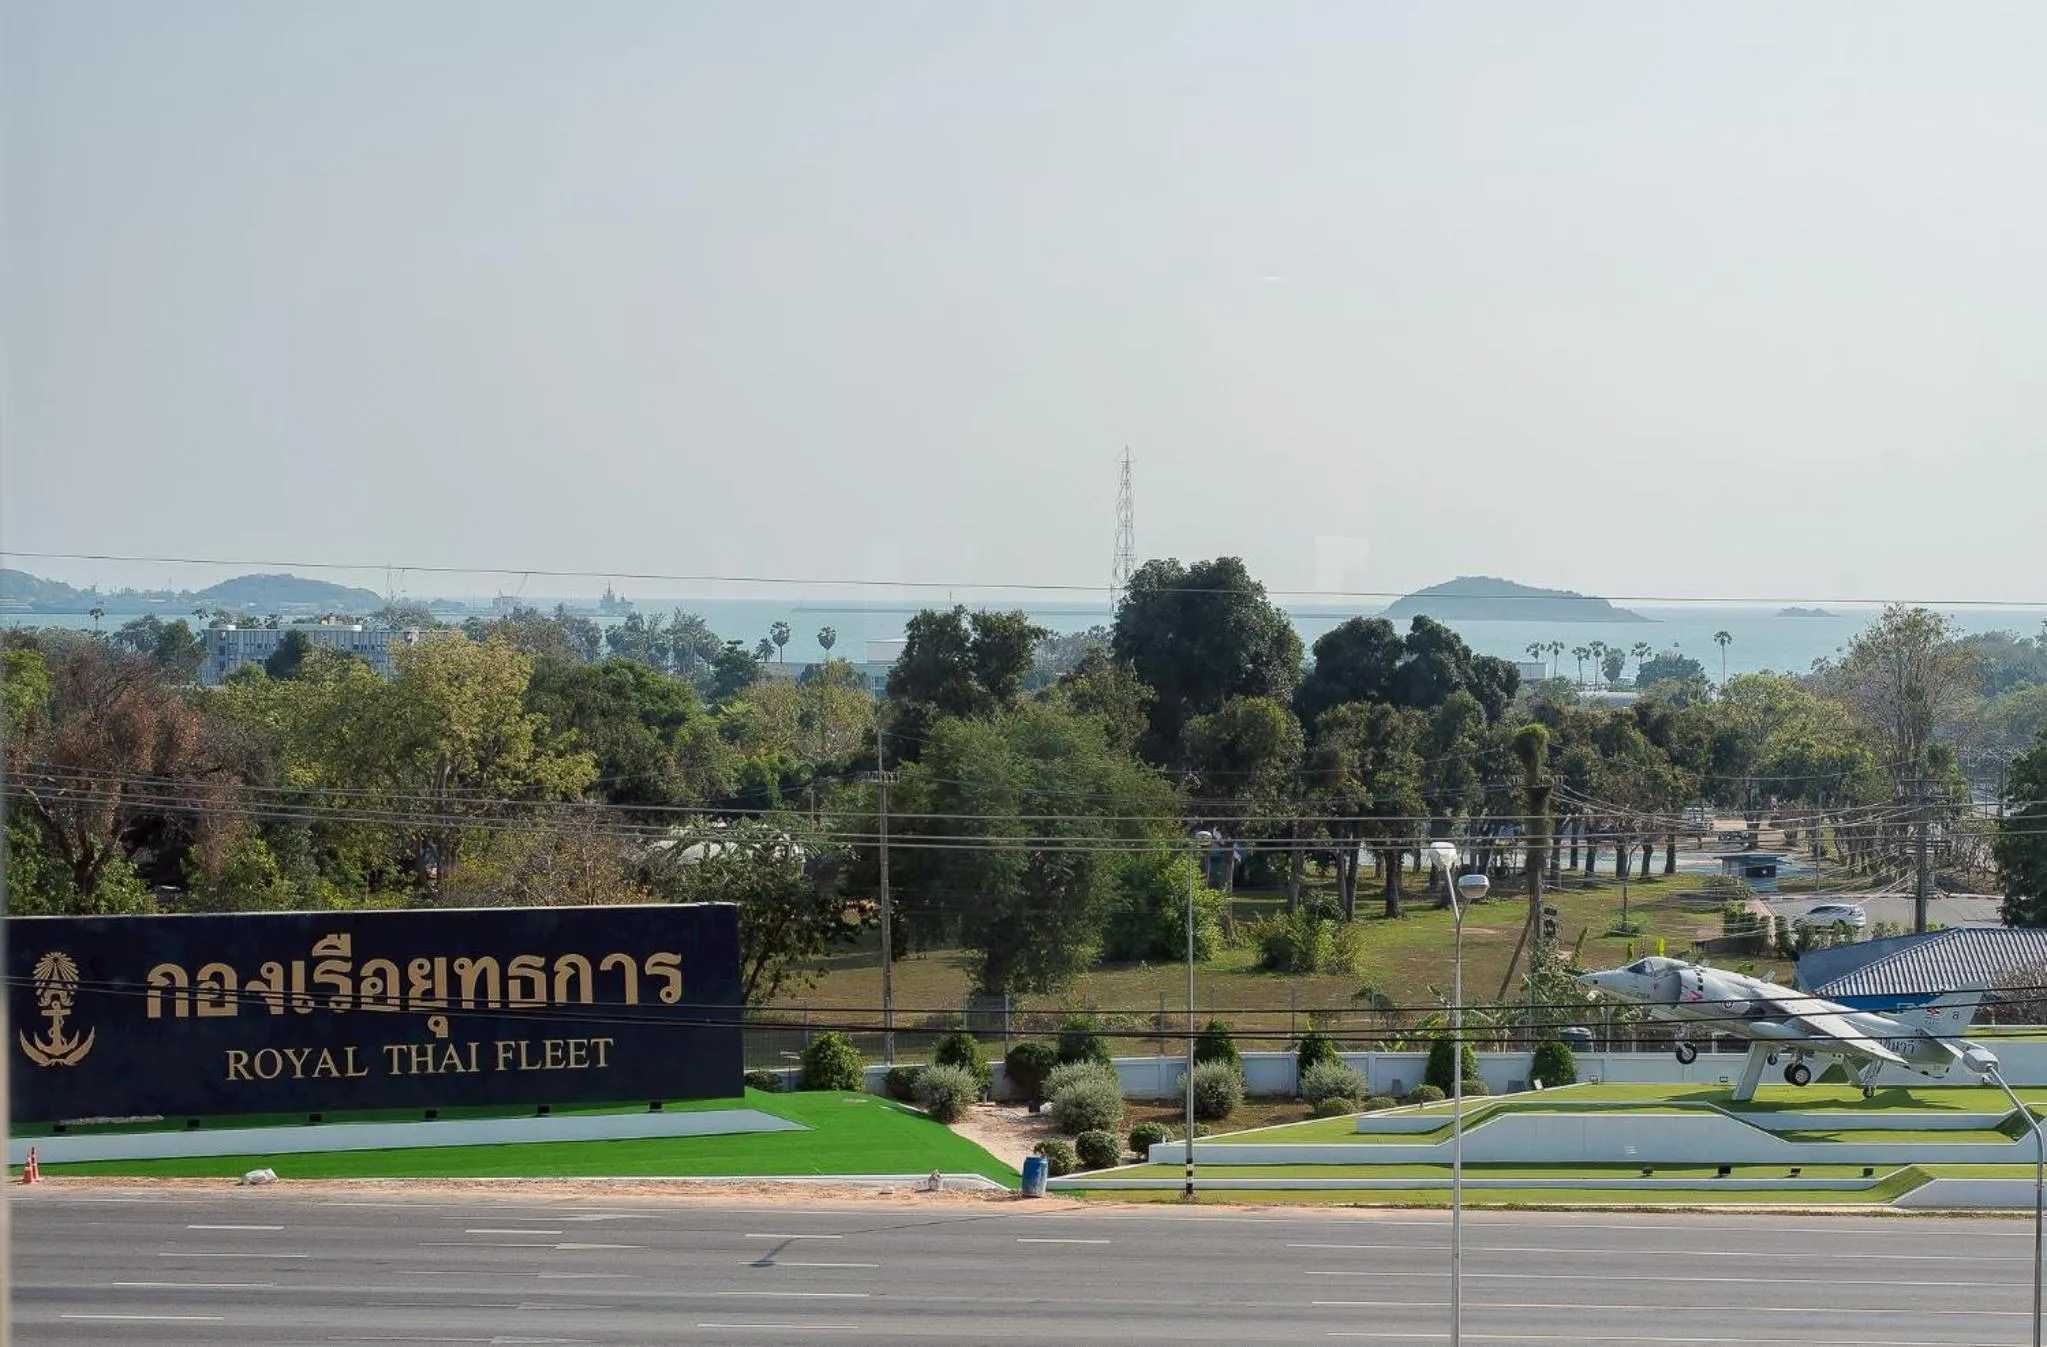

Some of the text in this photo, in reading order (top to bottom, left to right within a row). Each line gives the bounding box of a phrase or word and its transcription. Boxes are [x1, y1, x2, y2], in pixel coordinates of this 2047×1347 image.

[147, 933, 682, 1037] กองเรือยุทธการ
[226, 1038, 613, 1080] ROYAL THAI FLEET
